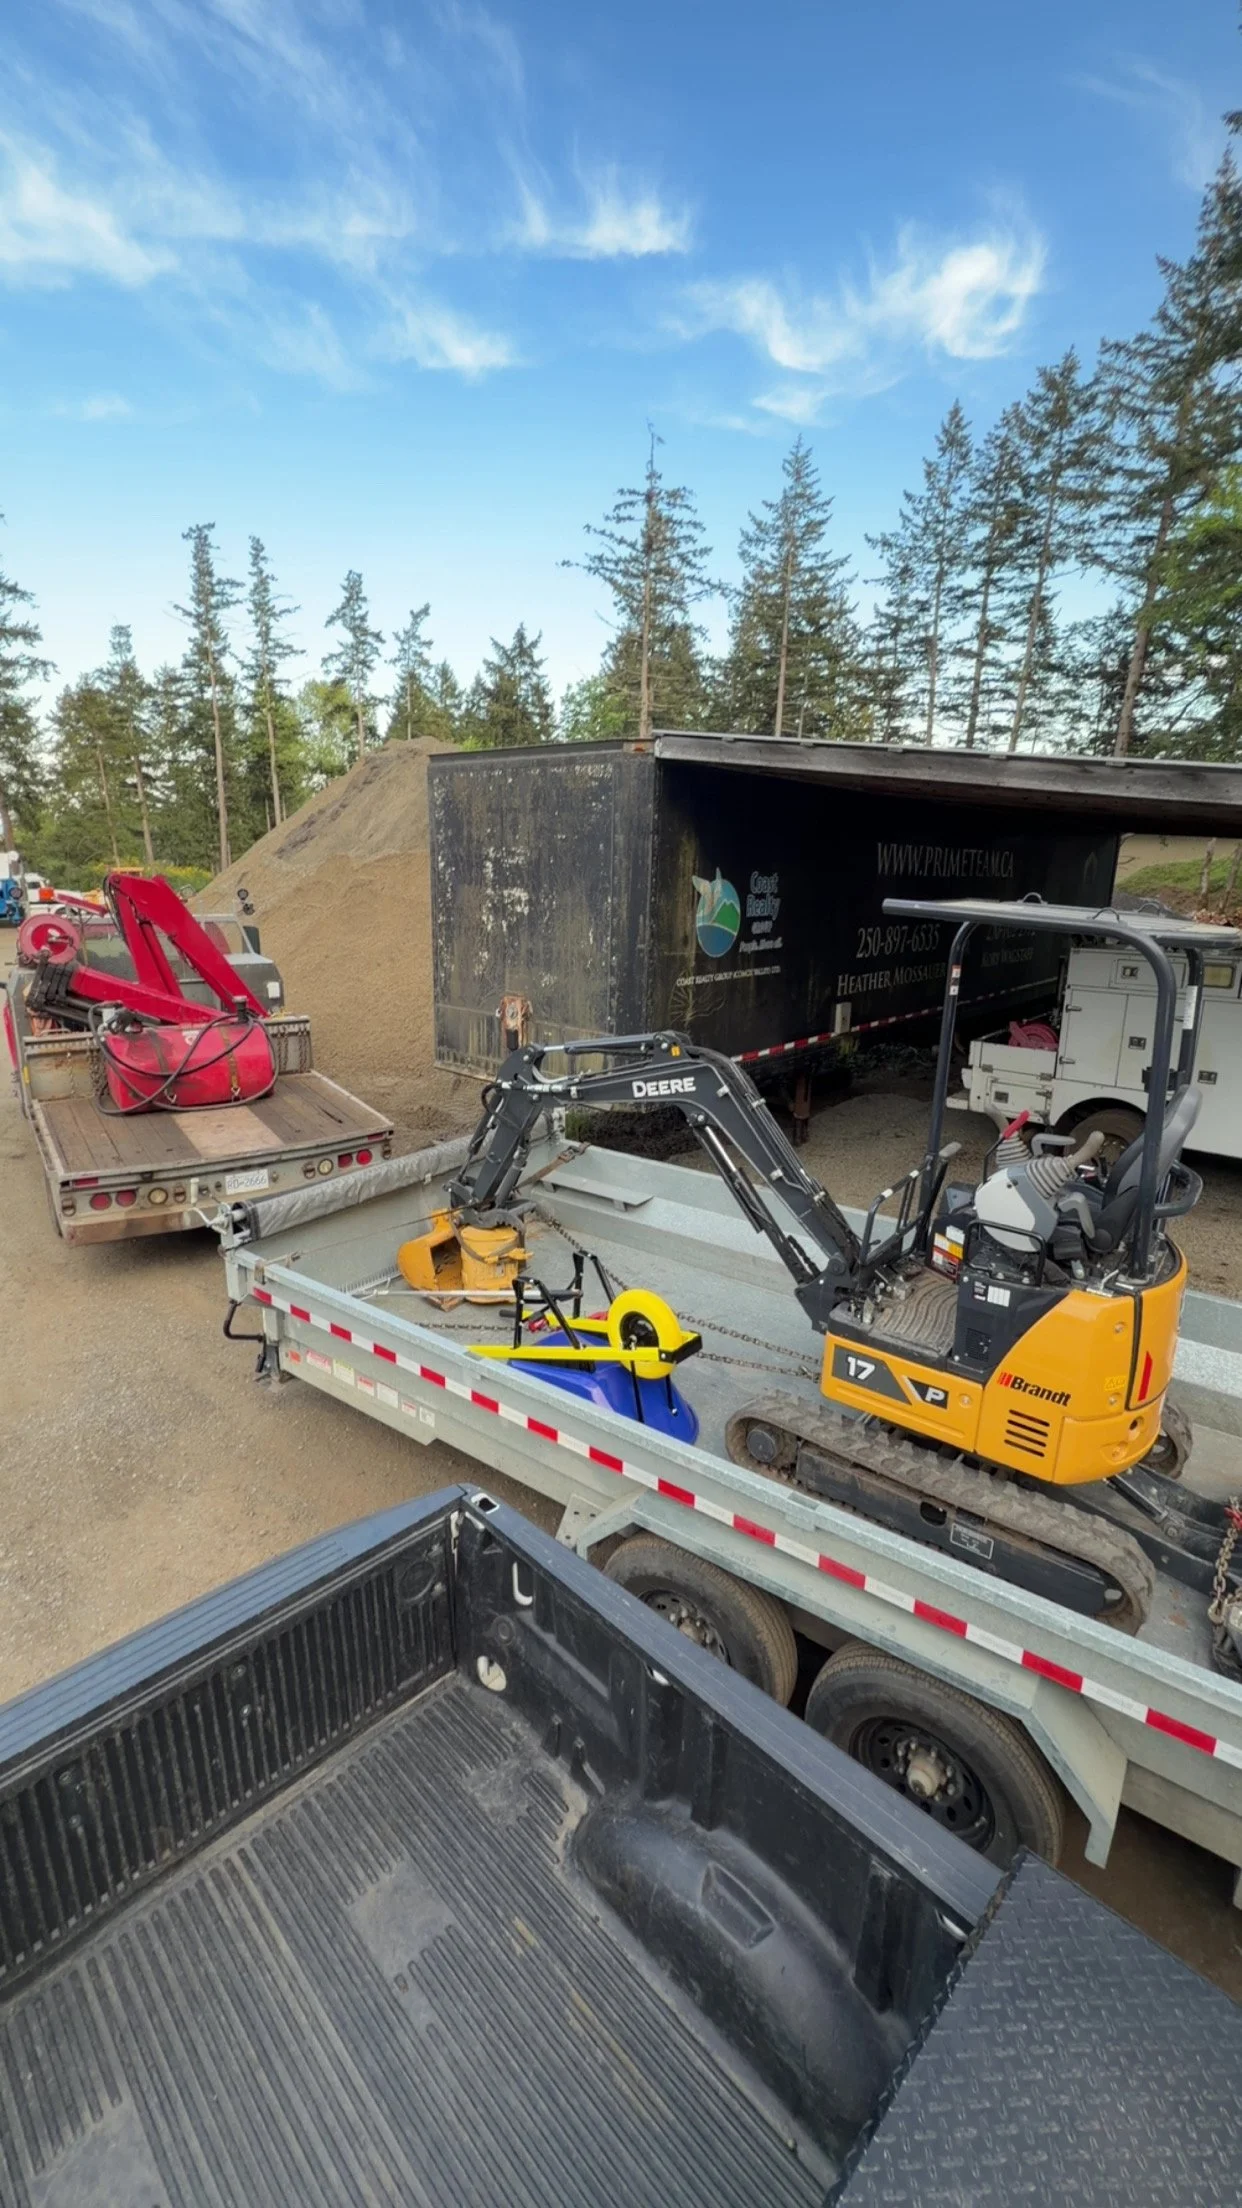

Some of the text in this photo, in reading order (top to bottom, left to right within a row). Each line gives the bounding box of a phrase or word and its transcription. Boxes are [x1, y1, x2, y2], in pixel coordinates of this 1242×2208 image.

[750, 871, 779, 894] Coast
[746, 893, 782, 921] Realty
[837, 969, 893, 997] HEATHER
[632, 1077, 696, 1098] DEERE
[846, 1356, 945, 1403] 17 P
[1009, 1376, 1072, 1407] Brandt
